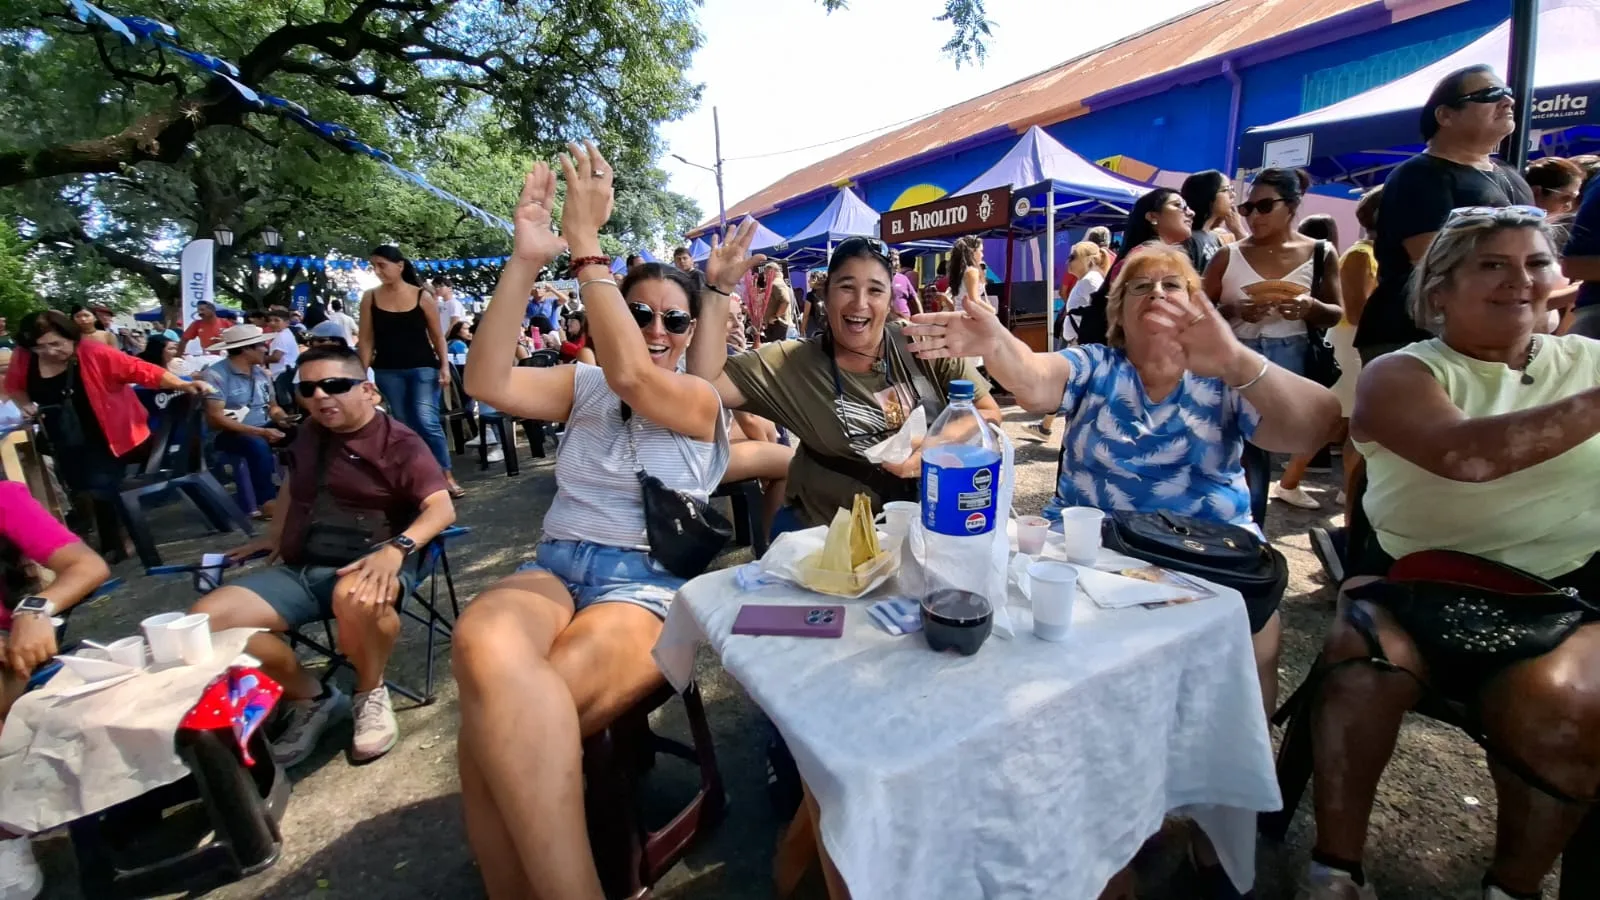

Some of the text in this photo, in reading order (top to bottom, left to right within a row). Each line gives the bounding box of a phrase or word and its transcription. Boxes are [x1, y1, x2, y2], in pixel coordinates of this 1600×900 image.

[1531, 110, 1586, 119] NICIPALIDAD
[891, 205, 968, 235] EL FAROLITO
